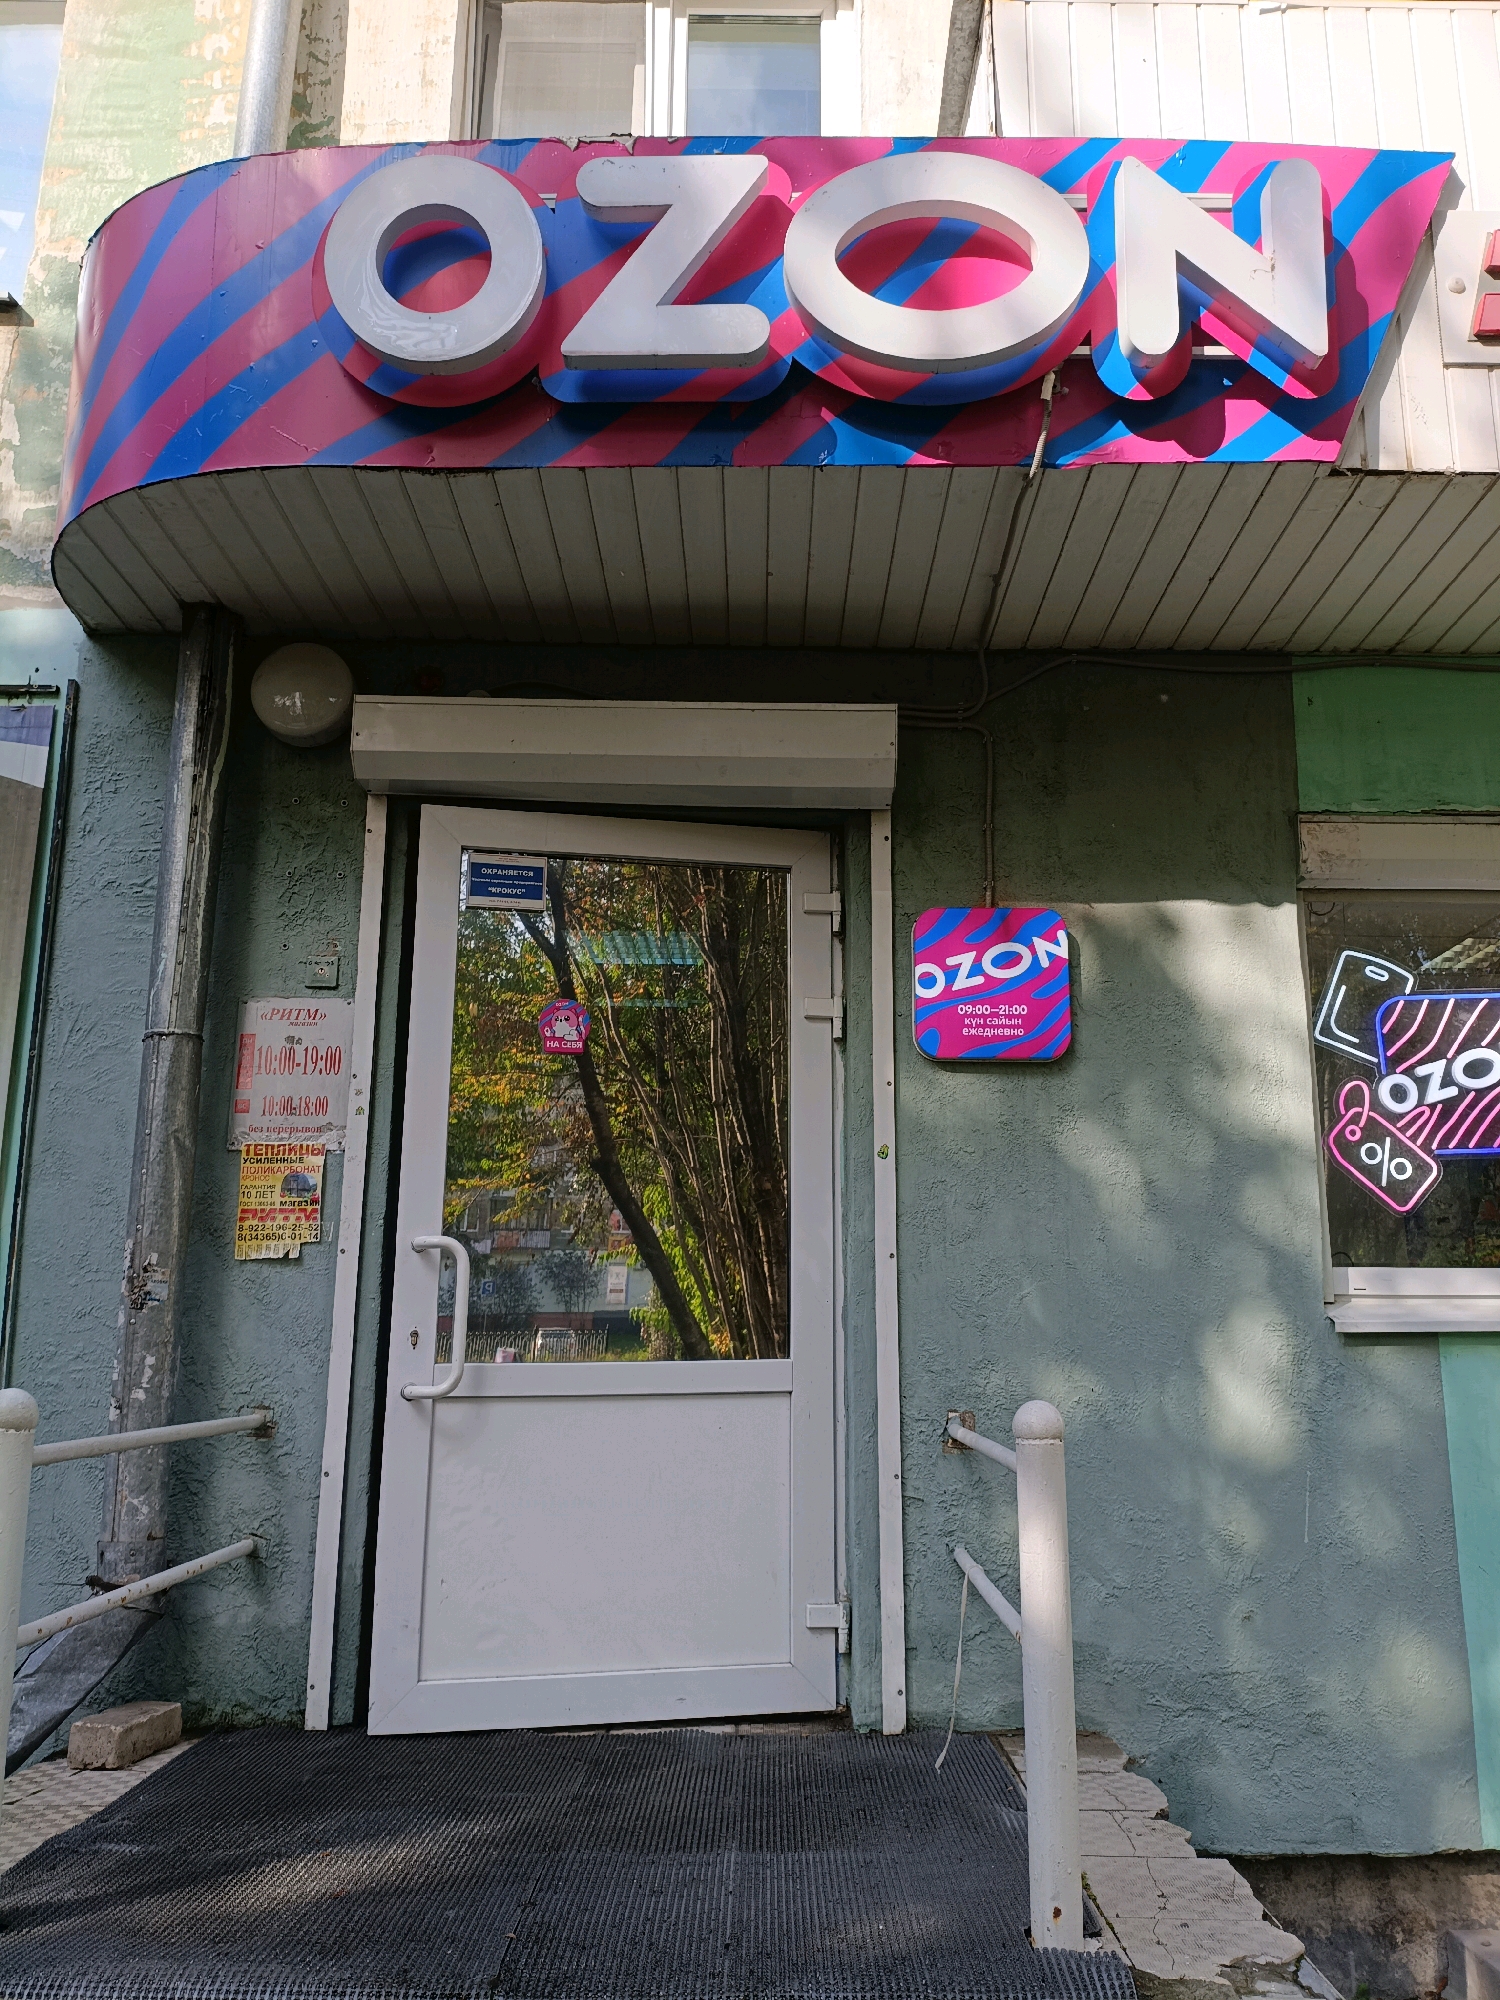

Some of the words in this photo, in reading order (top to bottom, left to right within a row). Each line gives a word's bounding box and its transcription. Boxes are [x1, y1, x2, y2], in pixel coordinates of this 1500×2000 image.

[323, 151, 1329, 375] OZON
[481, 867, 534, 877] ОХРАНЯЕТСЯ
[914, 929, 1068, 998] OZON
[260, 1008, 327, 1021] «РИТМ»
[964, 1016, 984, 1028] күн
[986, 1015, 1022, 1026] сайын
[962, 1027, 1024, 1038] ежедневно
[546, 1040, 560, 1048] НА
[255, 1045, 342, 1076] 10:00-19:00
[261, 1095, 329, 1116] 10:00-18:00
[248, 1124, 264, 1133] без
[244, 1143, 326, 1158] ТЕПЛИЦЫ
[242, 1156, 305, 1165] УСИЛЕННЫЕ
[241, 1165, 322, 1175] ПОЛИКАРБОНАТ
[241, 1174, 271, 1182] КРОНОС
[241, 1191, 252, 1199] 10
[254, 1191, 275, 1199] ЛЕТ
[238, 1207, 319, 1223] РИТМ
[237, 1223, 320, 1233] 8-922-196-25-52
